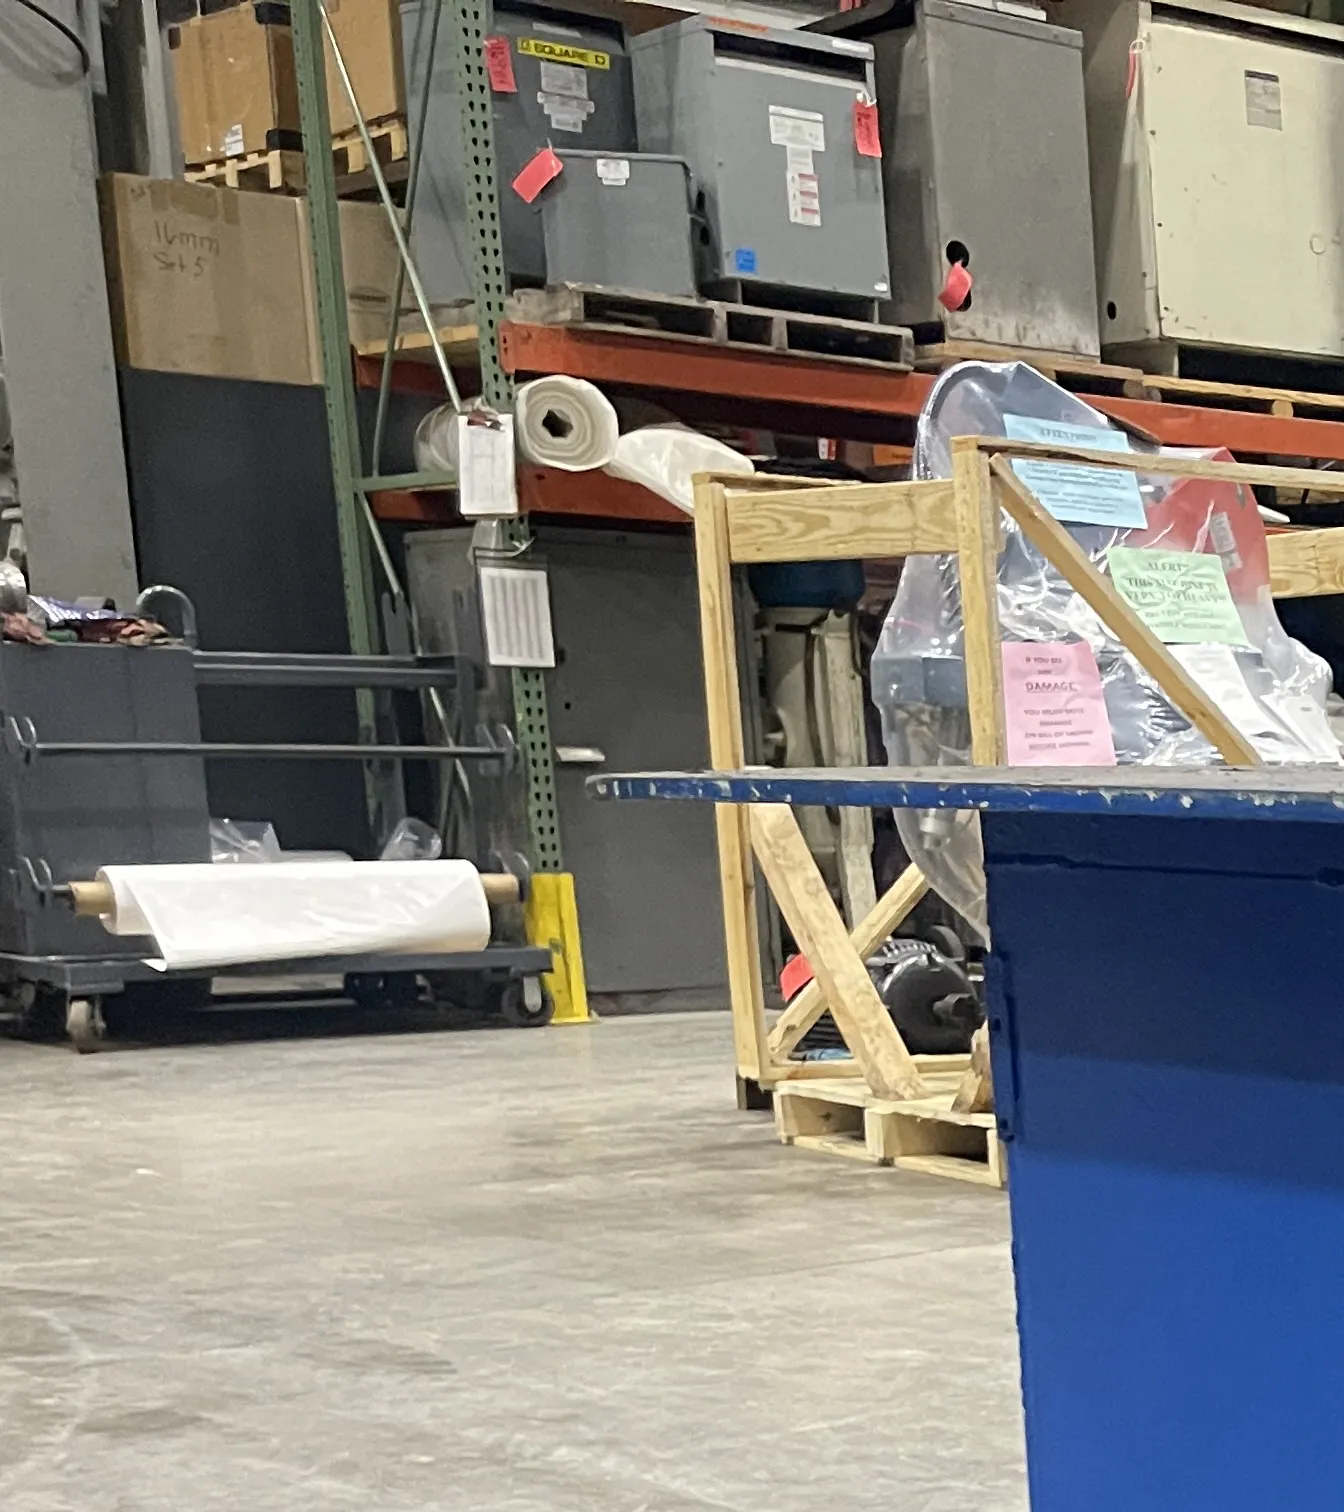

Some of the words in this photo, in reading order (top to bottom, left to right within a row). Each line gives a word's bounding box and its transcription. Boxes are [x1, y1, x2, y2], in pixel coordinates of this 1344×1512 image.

[534, 43, 589, 63] SQUARE
[594, 55, 606, 65] D
[1025, 681, 1078, 693] DAMAGE
